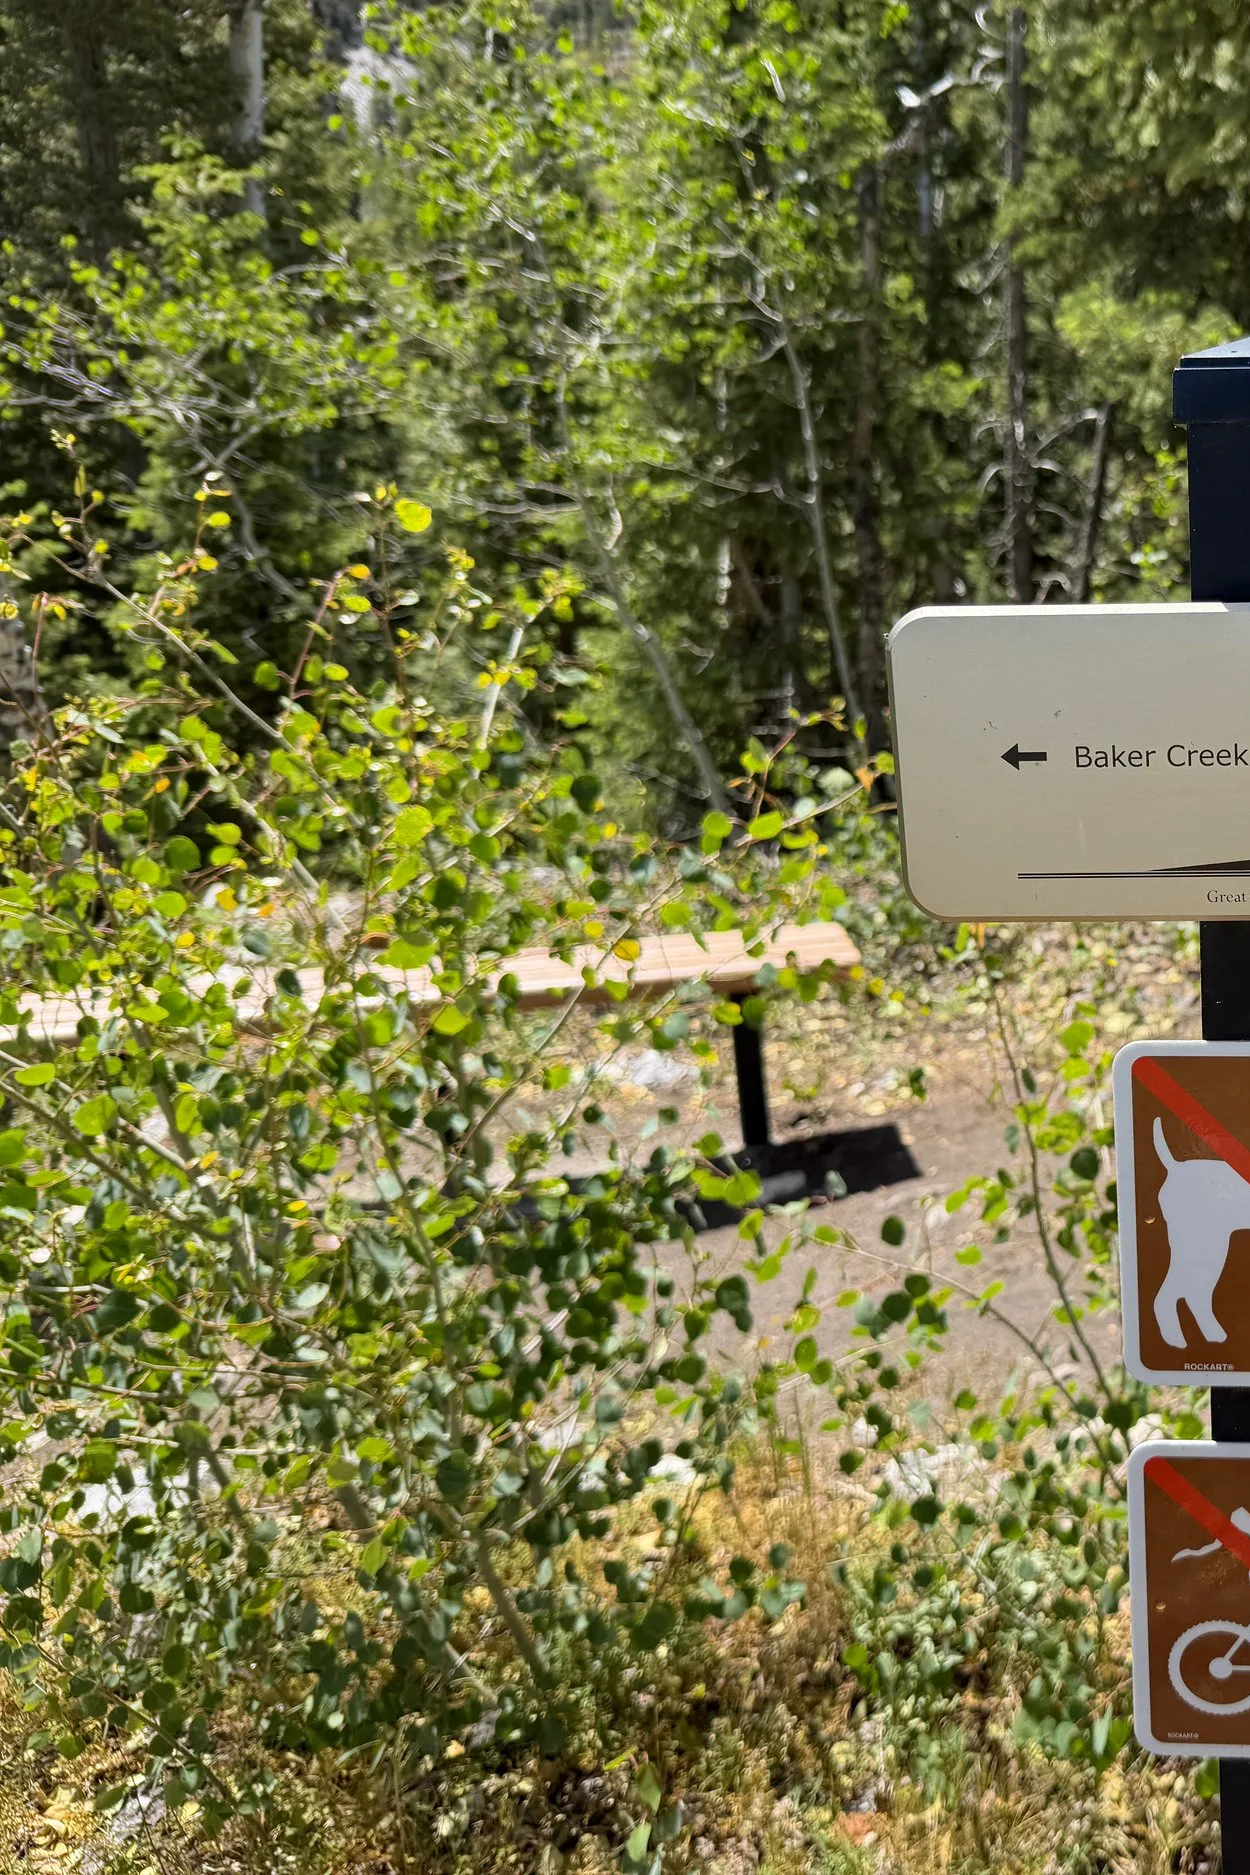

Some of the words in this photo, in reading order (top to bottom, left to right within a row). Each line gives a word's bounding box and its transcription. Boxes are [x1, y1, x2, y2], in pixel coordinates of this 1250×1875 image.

[1075, 745, 1156, 768] Baker
[1167, 744, 1249, 767] Creek
[1206, 889, 1247, 903] Great
